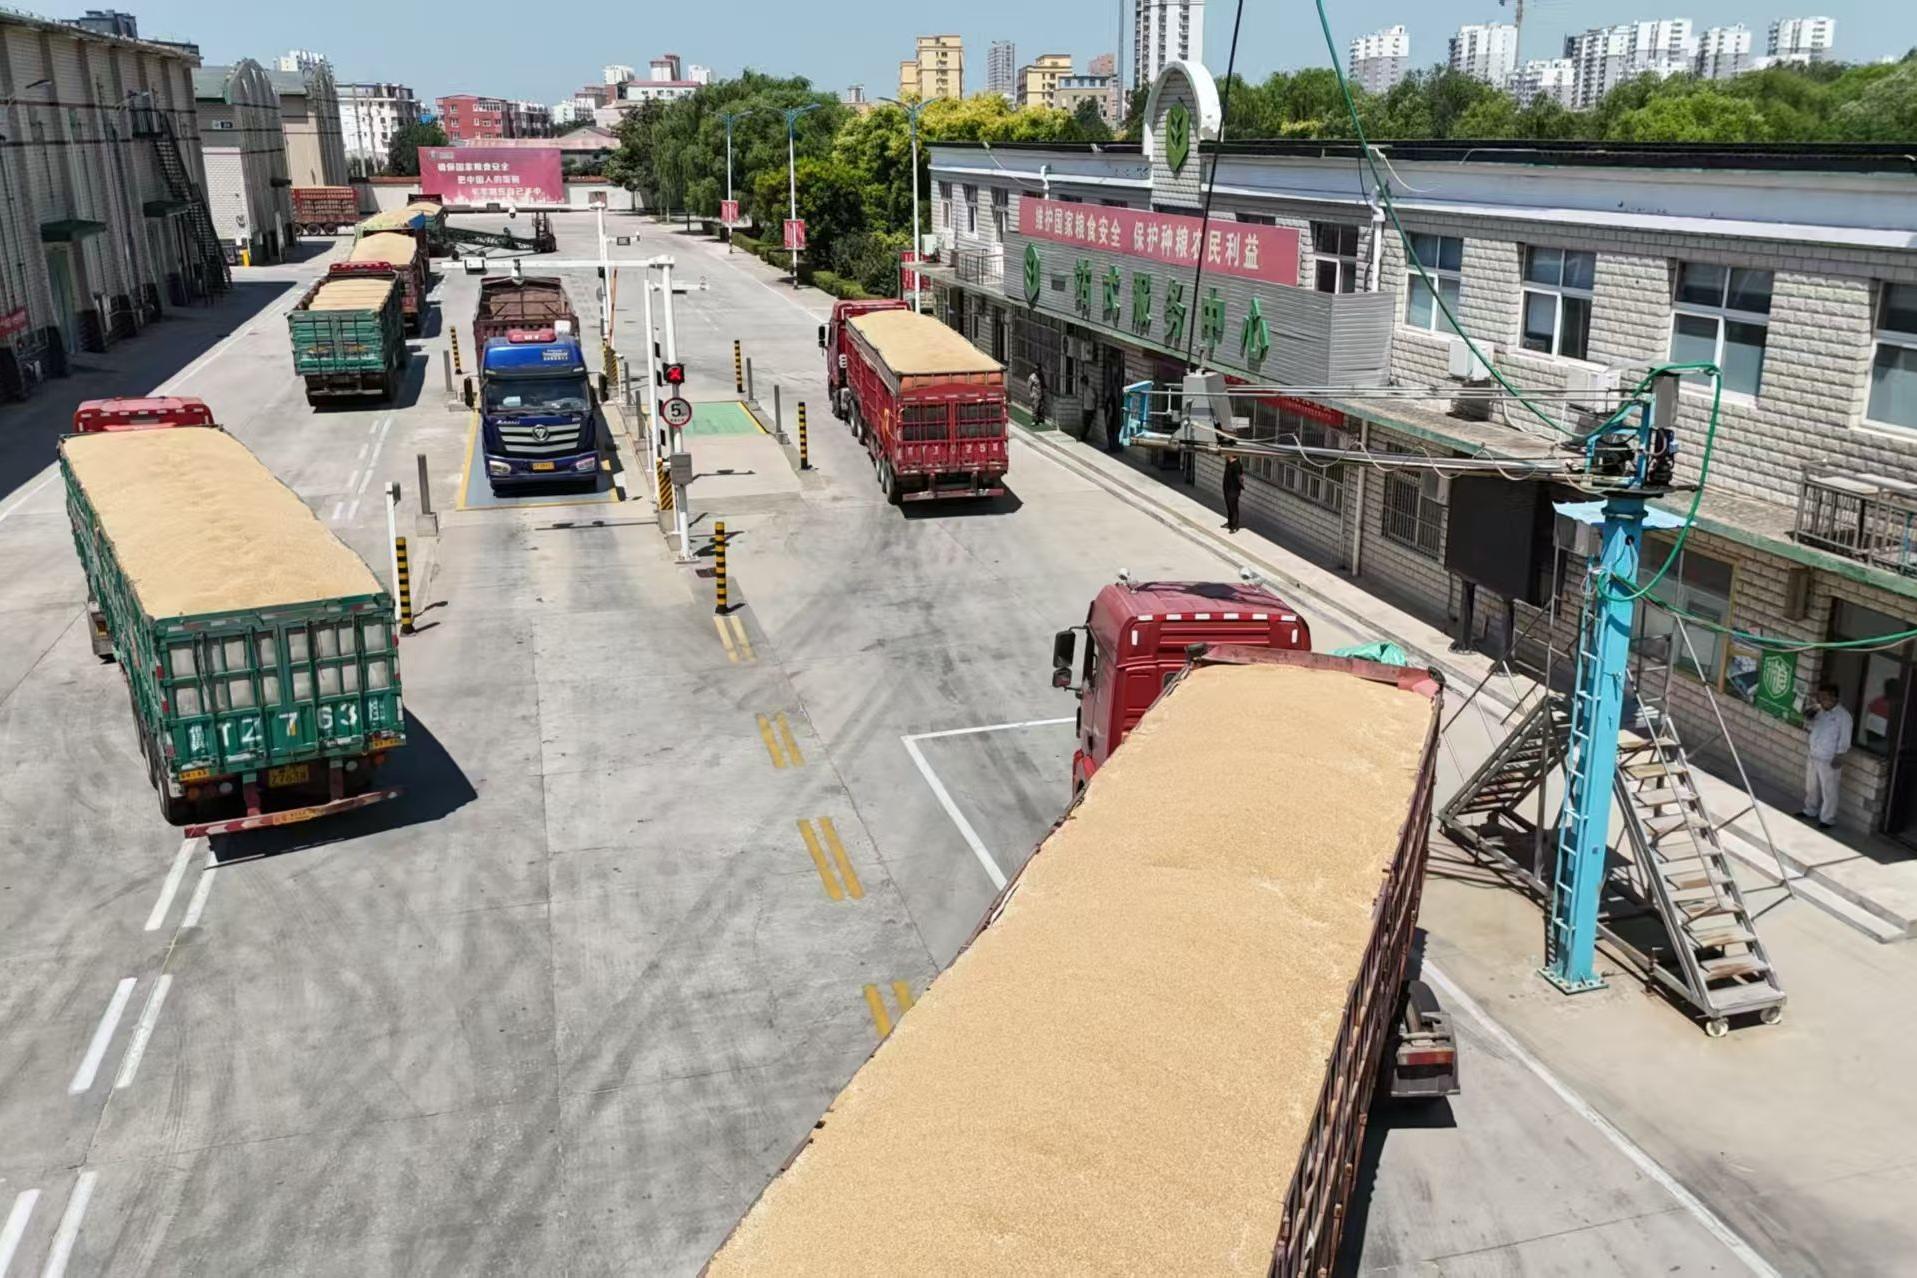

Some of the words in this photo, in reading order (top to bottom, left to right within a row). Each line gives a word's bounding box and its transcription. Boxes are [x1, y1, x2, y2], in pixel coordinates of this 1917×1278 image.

[1035, 206, 1121, 248] 维护国家粮食安全
[1133, 219, 1260, 270] 保护种粮农民利益
[671, 403, 681, 417] 5
